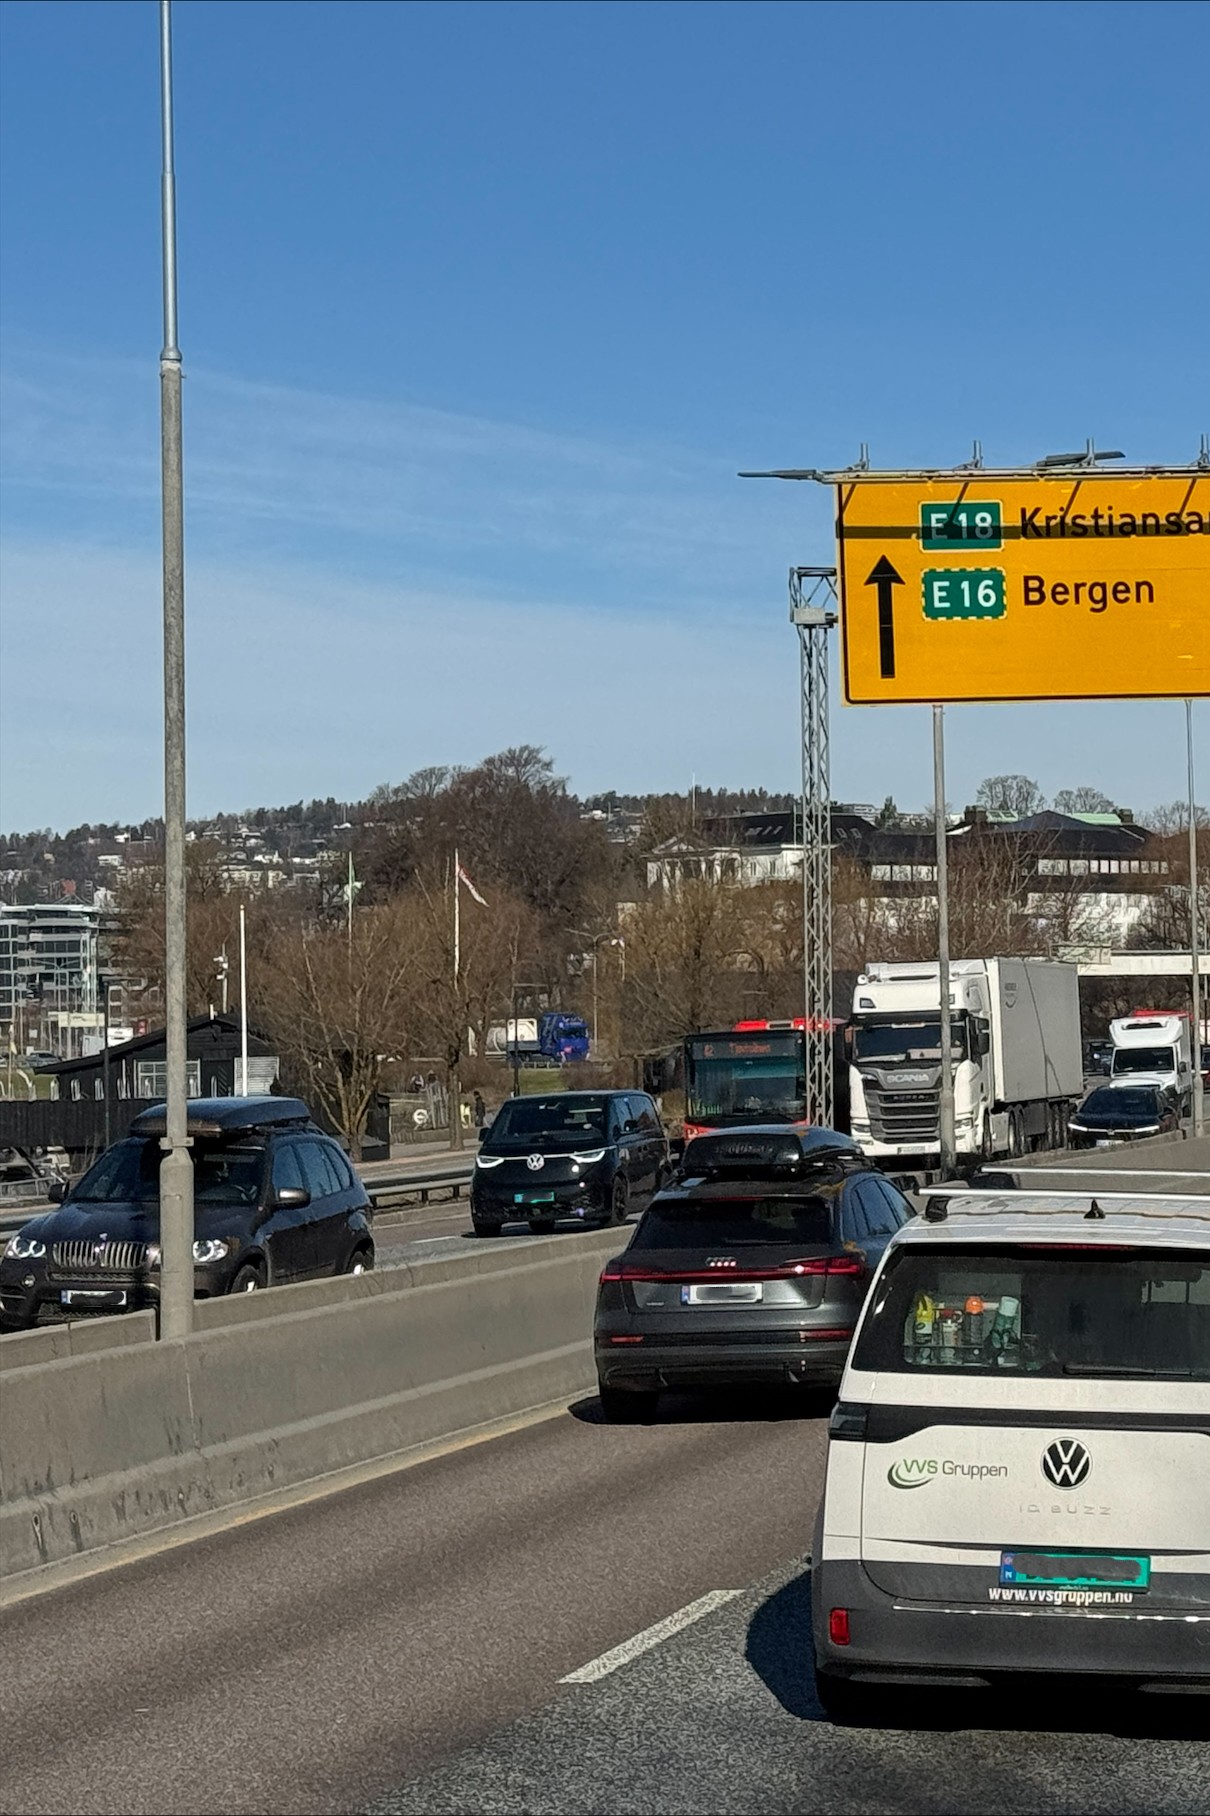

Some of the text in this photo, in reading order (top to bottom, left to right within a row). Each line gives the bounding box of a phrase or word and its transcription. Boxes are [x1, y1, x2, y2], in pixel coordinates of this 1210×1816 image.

[1023, 574, 1155, 613] Bergen
[886, 1074, 930, 1084] SCANIA
[903, 1459, 1008, 1480] VVS Gruppen
